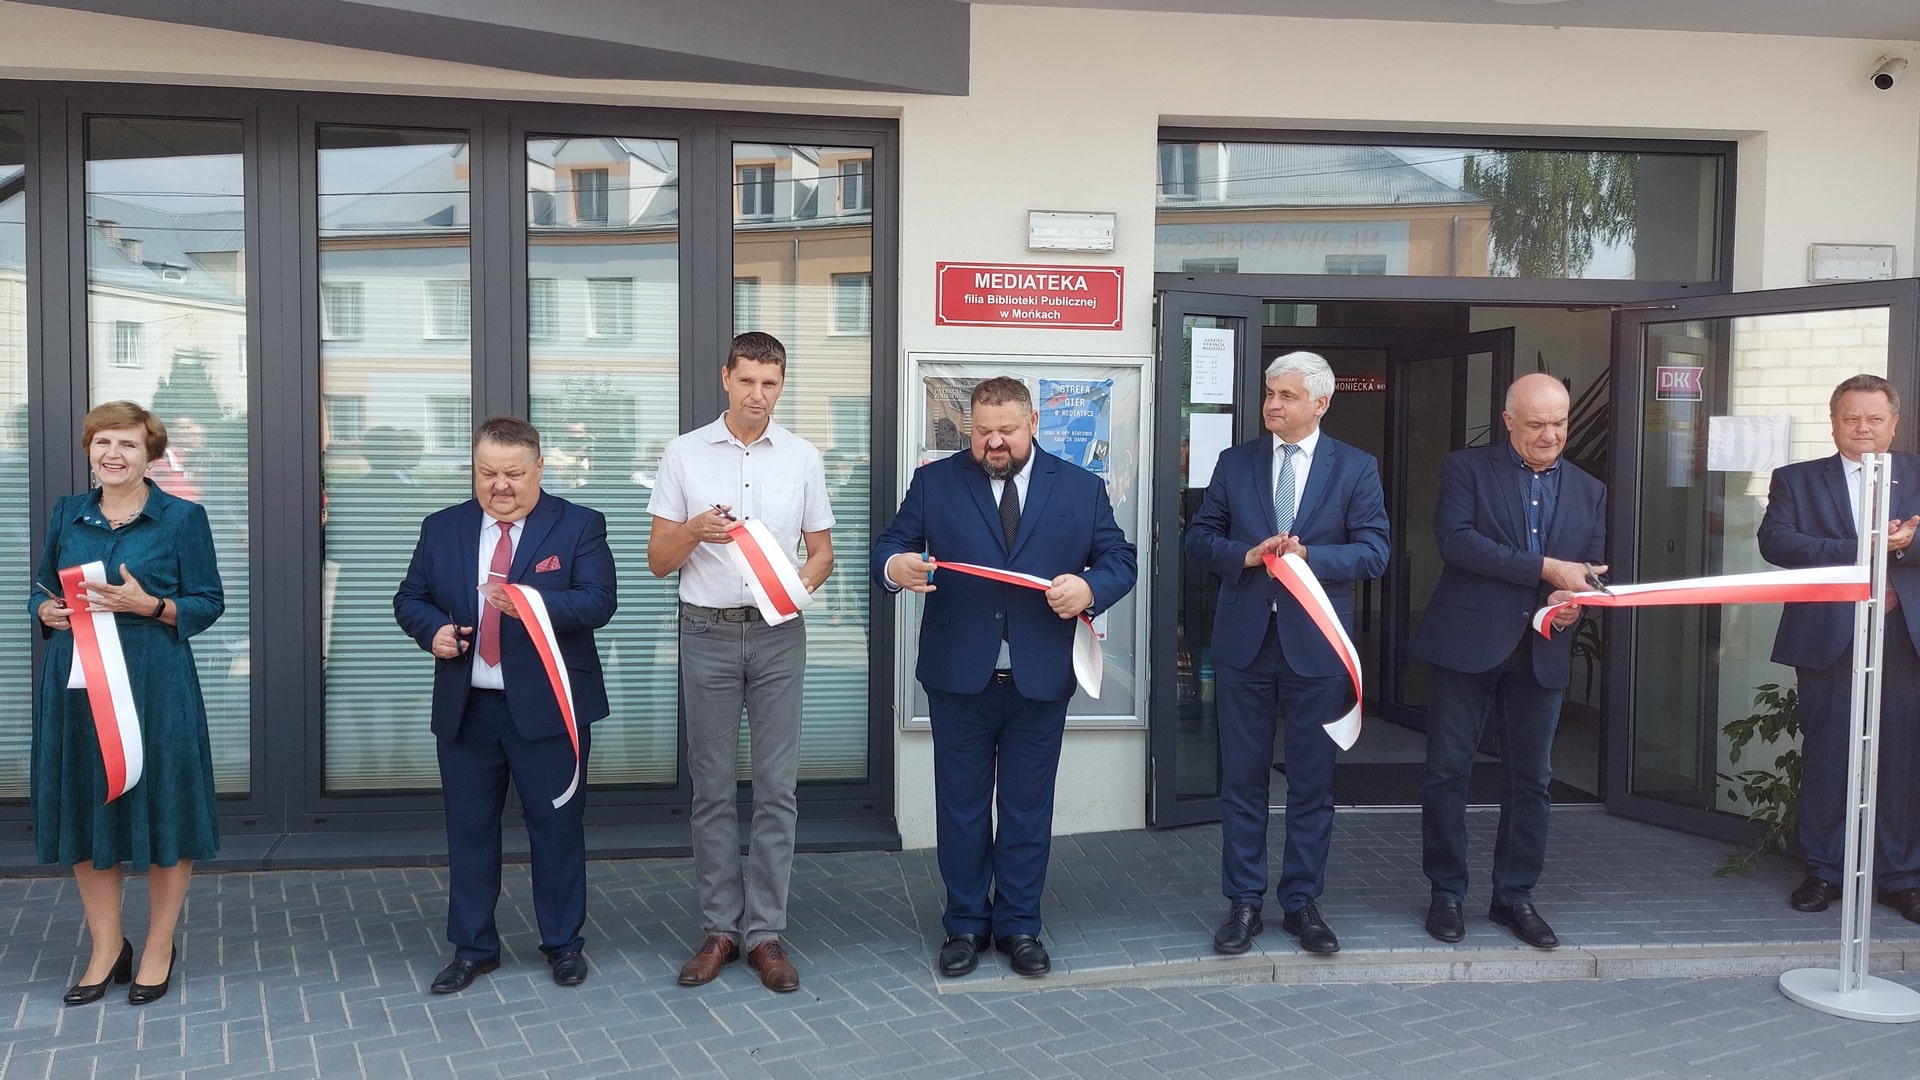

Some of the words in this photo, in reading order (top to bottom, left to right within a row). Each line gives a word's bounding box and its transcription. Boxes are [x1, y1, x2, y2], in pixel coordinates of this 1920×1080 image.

[974, 272, 1089, 291] MEDIATEKA
[963, 294, 984, 304] filia
[987, 295, 1038, 305] Biblioteki
[1041, 296, 1097, 308] Publicznej
[1000, 310, 1009, 318] w
[1012, 308, 1061, 320] Mońkach
[1060, 384, 1091, 394] STREFA
[1064, 397, 1086, 407] GIER
